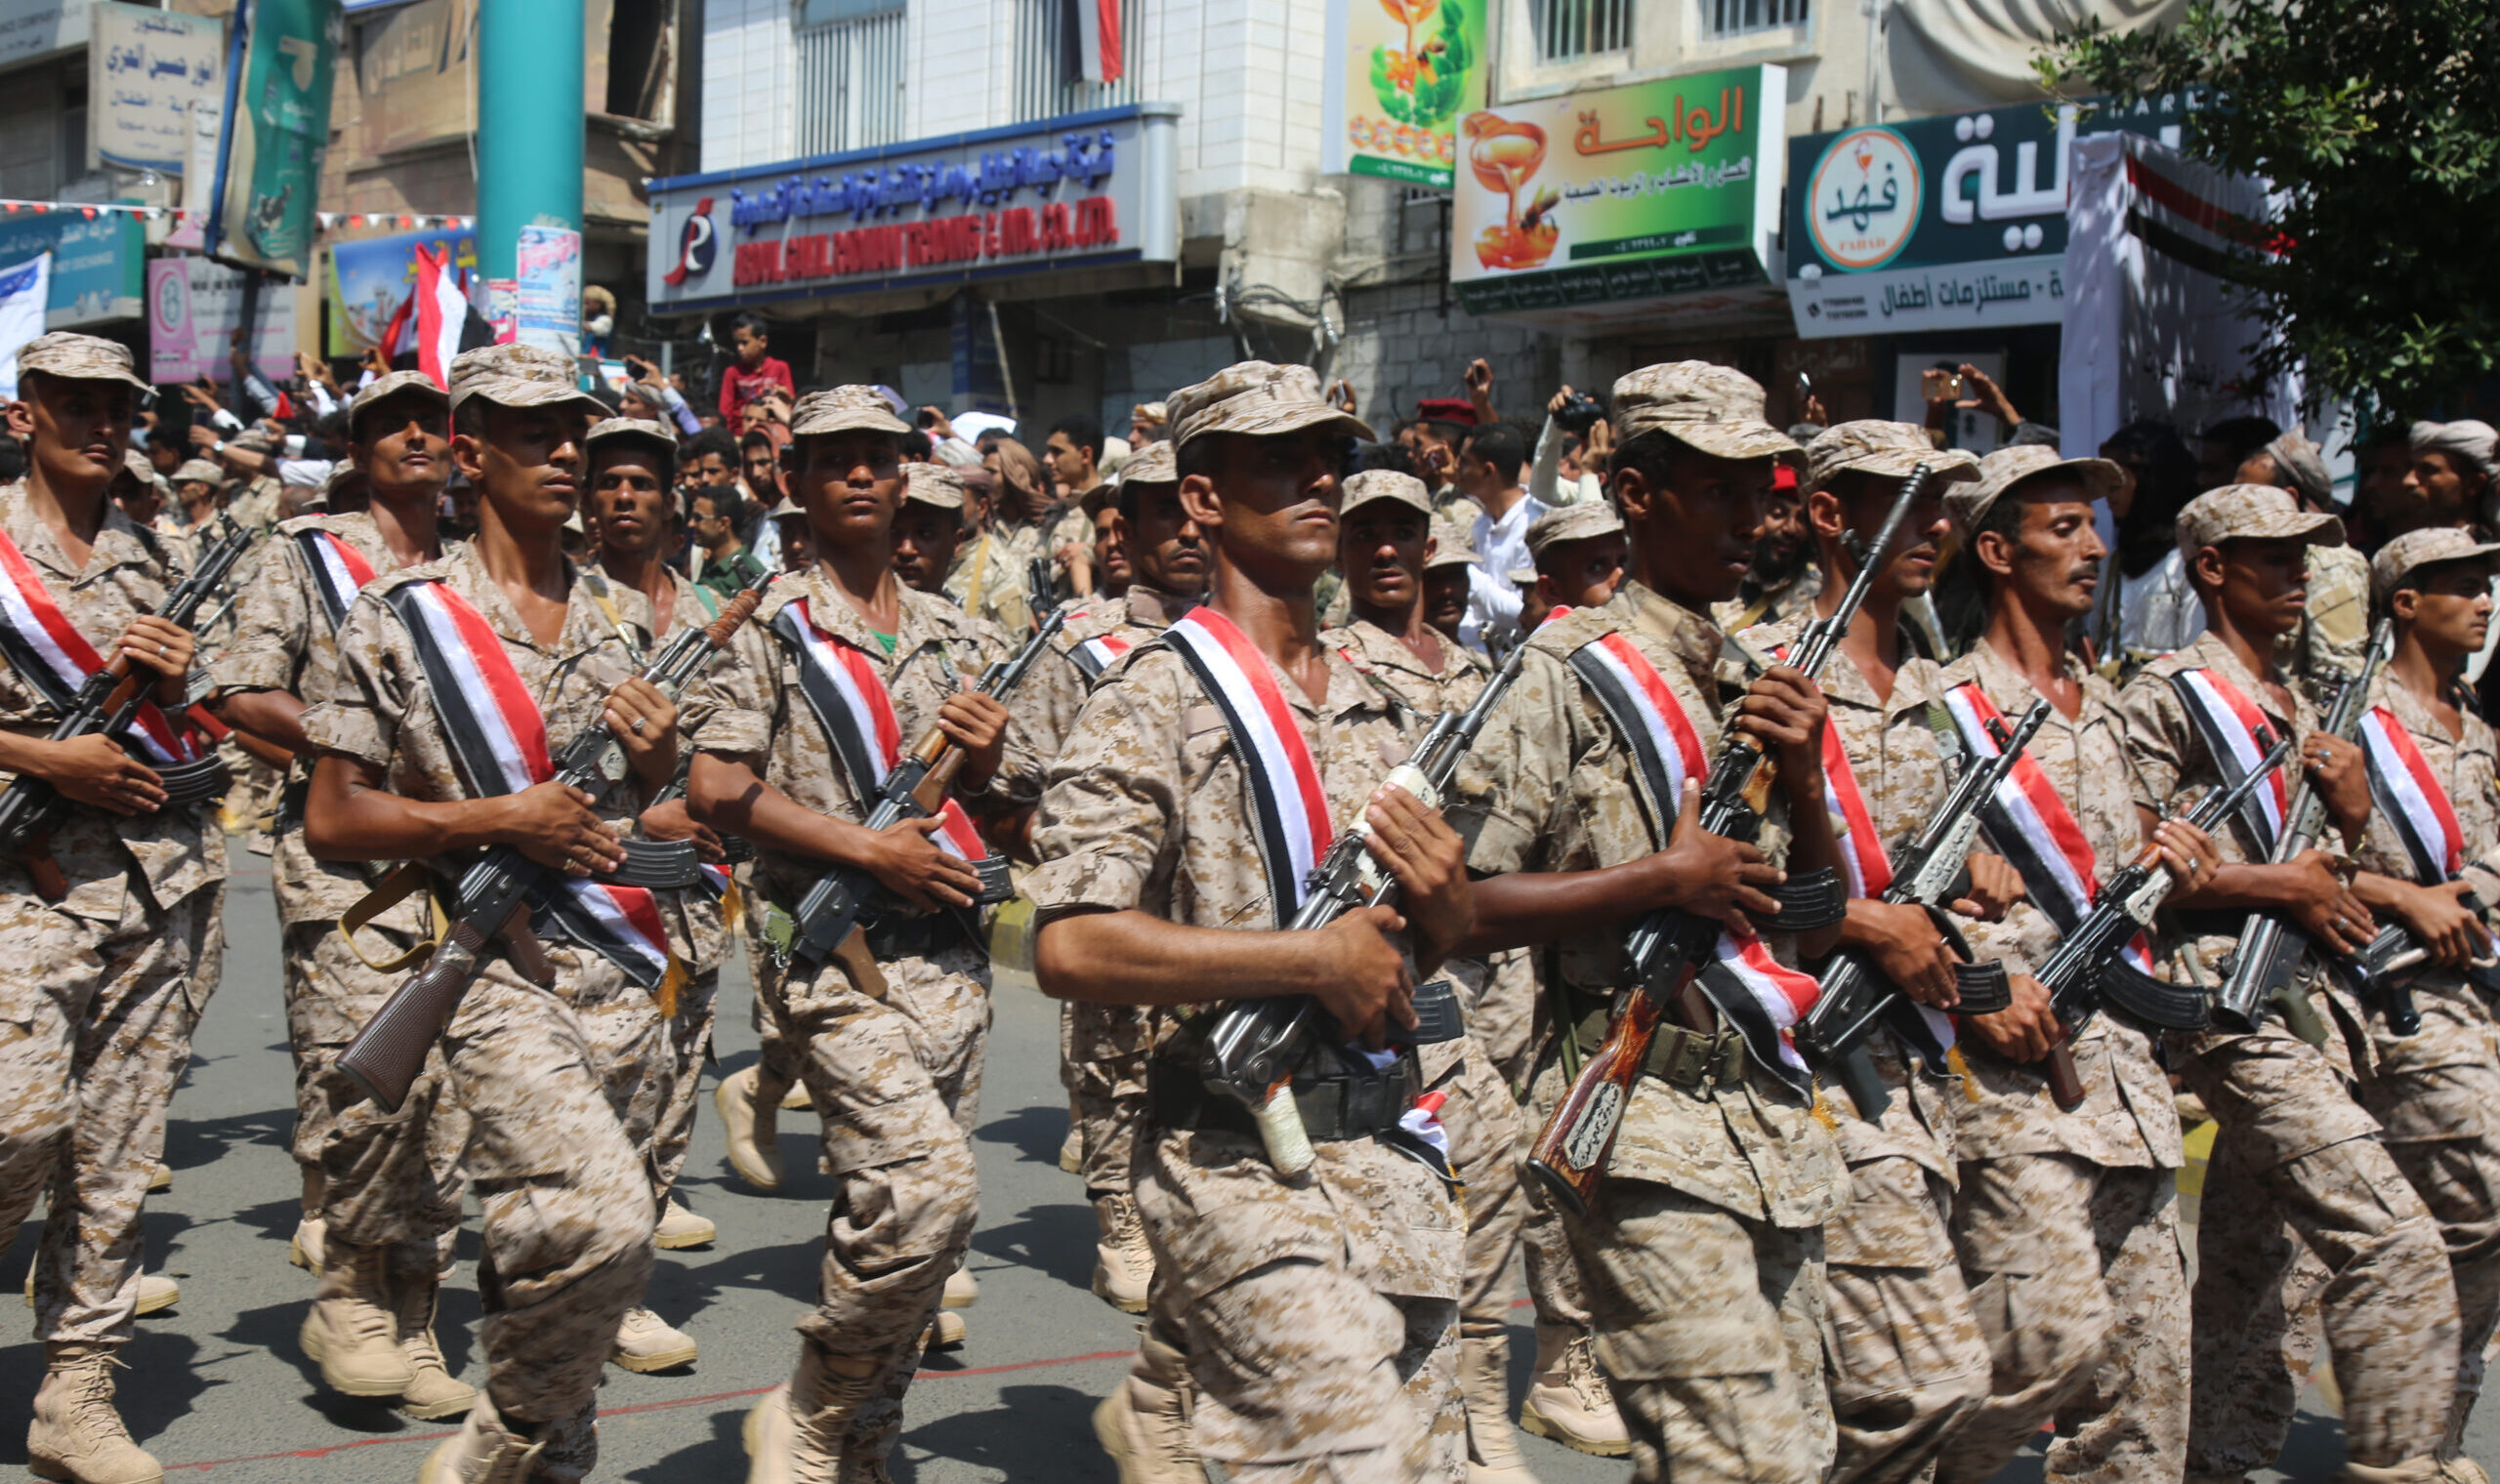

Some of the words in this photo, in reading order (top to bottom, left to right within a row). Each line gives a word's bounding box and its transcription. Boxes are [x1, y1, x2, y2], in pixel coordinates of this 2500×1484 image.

[1574, 85, 1744, 156] الواحة
[1825, 161, 1899, 233] فهد
[903, 213, 982, 267] TRADING
[1074, 195, 1119, 248] LTD.
[1838, 236, 1887, 253] FAHAD
[1880, 275, 1934, 317] أطفال
[1938, 274, 2030, 313] مستلزمات
